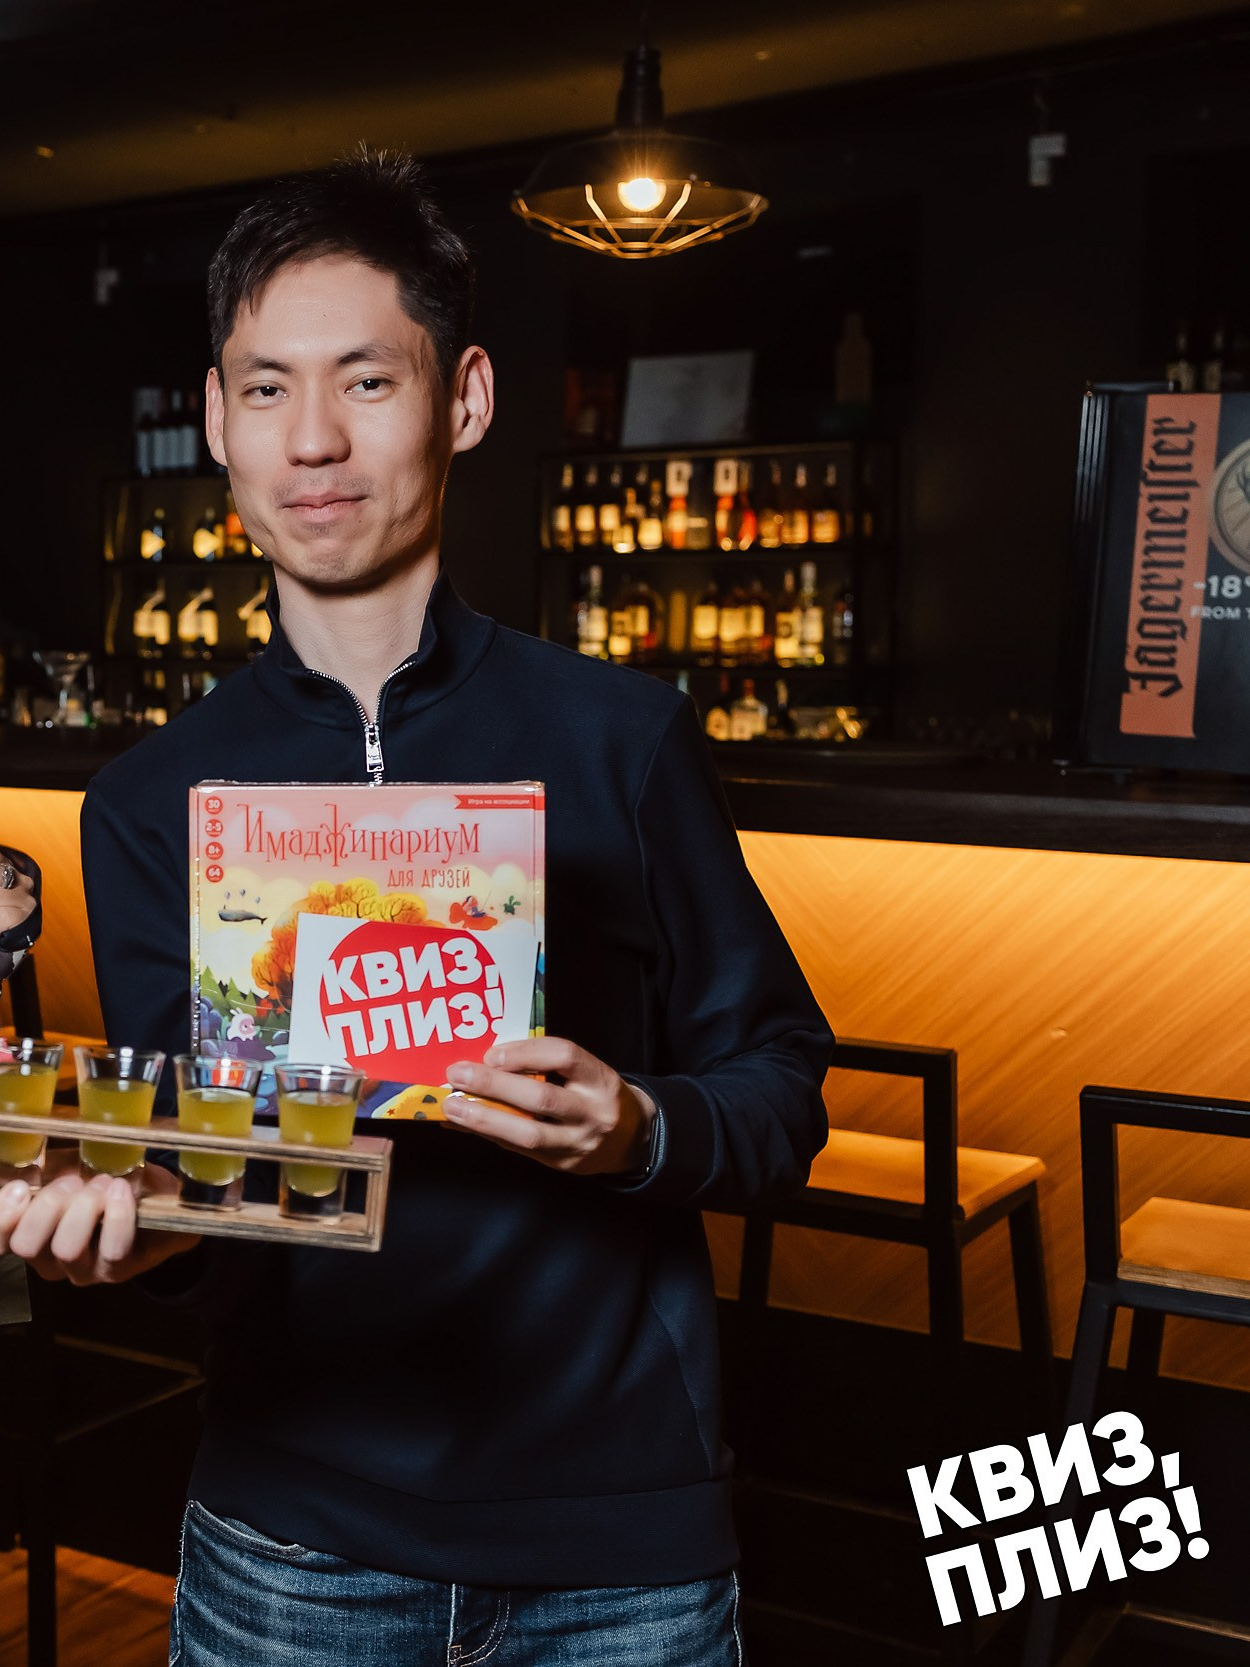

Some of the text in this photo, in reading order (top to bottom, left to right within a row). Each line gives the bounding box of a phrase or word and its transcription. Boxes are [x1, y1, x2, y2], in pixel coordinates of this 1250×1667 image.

[1190, 605, 1241, 620] FROM
[237, 803, 480, 867] Имаджинариум
[421, 867, 470, 888] ДРУЗЕЙ
[323, 937, 500, 1005] КВИЗ,
[325, 988, 503, 1057] ПЛИЗ!
